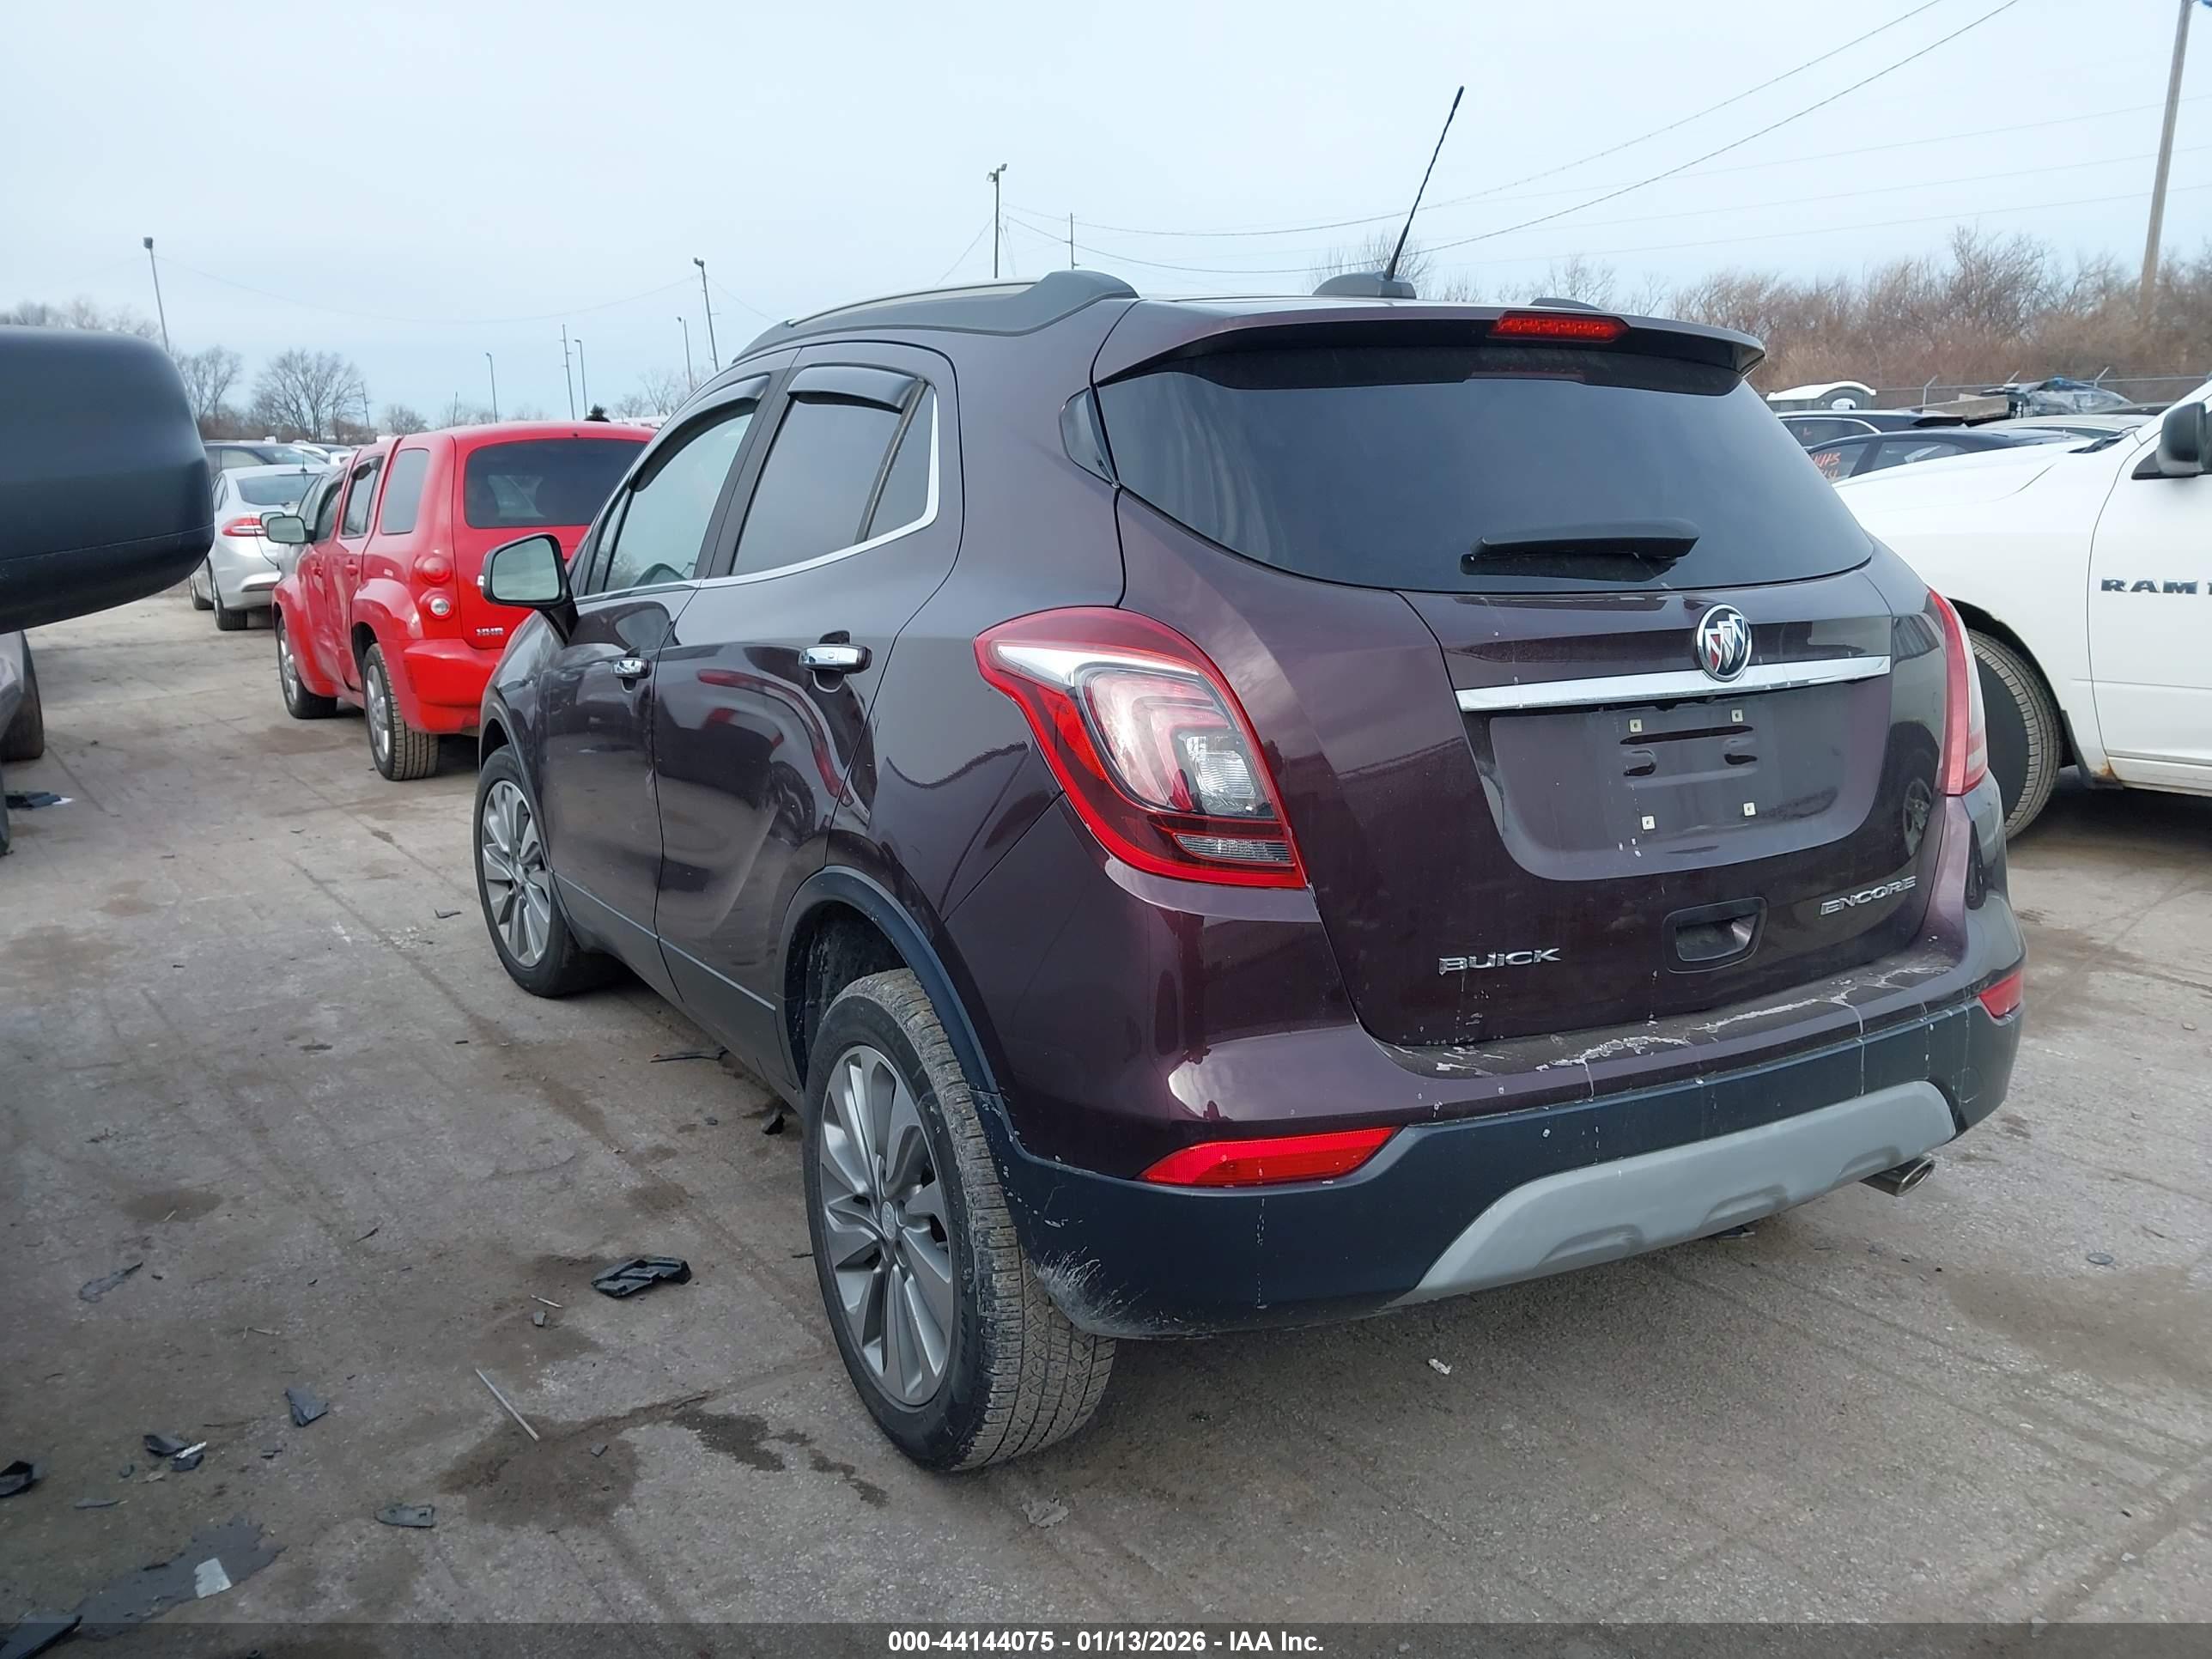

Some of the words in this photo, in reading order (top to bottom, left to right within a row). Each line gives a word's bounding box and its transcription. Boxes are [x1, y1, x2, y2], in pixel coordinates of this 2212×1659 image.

[2100, 577, 2198, 594] RAM
[1820, 876, 1917, 915] ENCORE
[1438, 948, 1562, 975] BUICK
